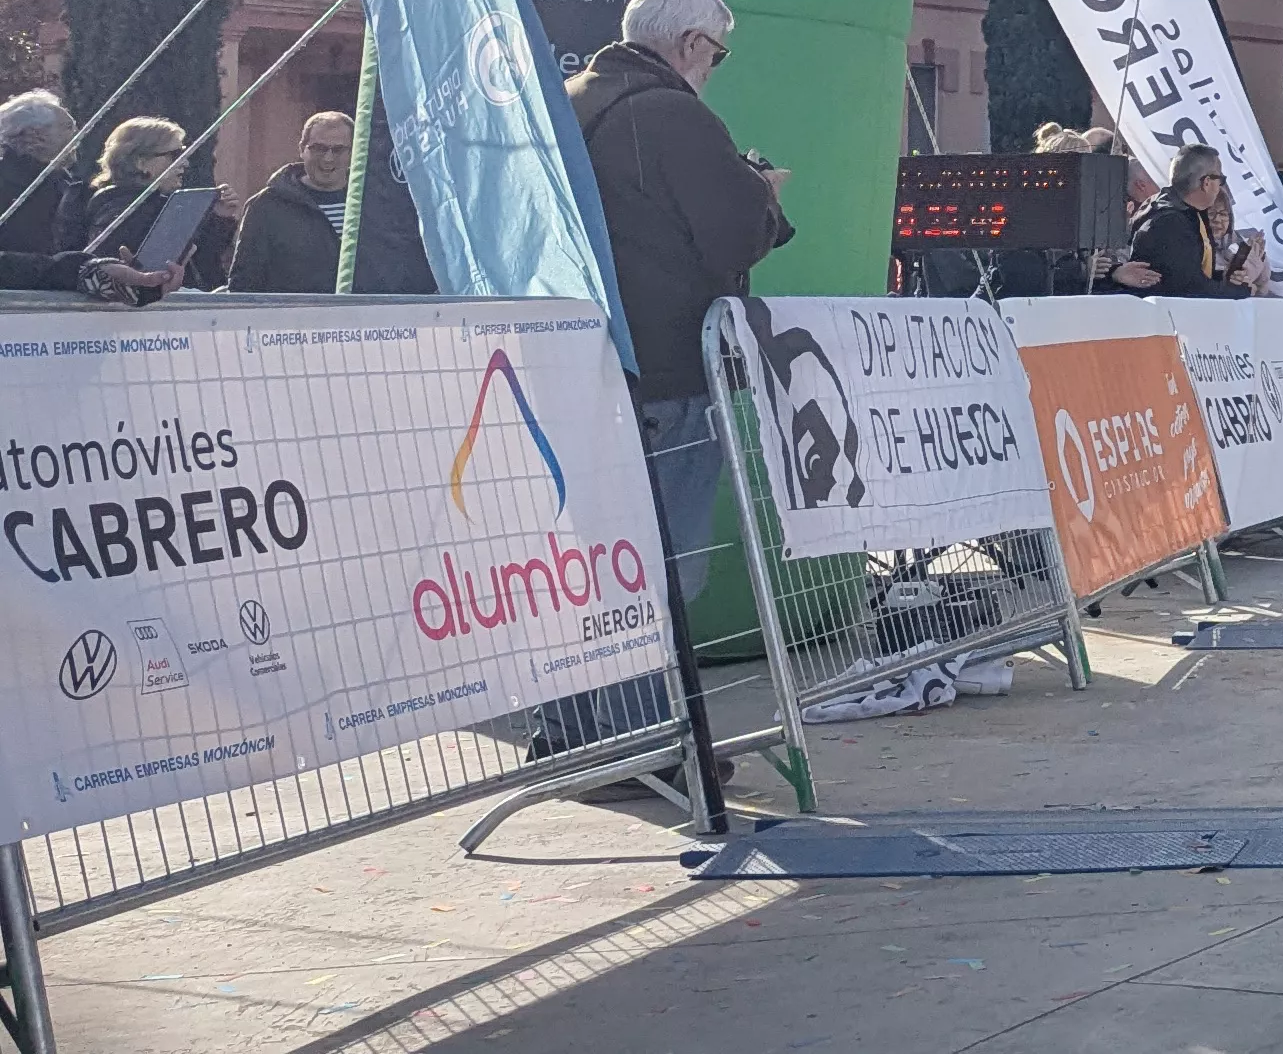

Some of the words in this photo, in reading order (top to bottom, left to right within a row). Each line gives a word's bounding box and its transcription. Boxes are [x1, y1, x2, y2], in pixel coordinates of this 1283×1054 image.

[54, 340, 117, 356] EMPRESAS
[120, 334, 190, 353] MONZÓNCM
[261, 329, 309, 347] CARRERA
[311, 328, 362, 345] EMPRESAS
[364, 325, 417, 342] MONZÓNCM
[474, 323, 512, 337] CARRERA
[514, 320, 555, 333] EMPRESAS
[556, 317, 602, 332] MONZÓNCM
[851, 300, 1000, 380] DIPUTACIÓN
[0, 418, 239, 491] tomóviles
[869, 407, 912, 474] DE
[913, 402, 1021, 472] HUESCA
[4, 479, 309, 584] CABRERO
[413, 531, 648, 643] alumbra
[582, 594, 656, 642] ENERGÍA
[146, 657, 171, 672] Audi
[146, 671, 184, 687] Service
[544, 653, 582, 675] CARRERA
[338, 709, 386, 731] CARRERA
[386, 694, 435, 719] EMPRESAS
[438, 679, 488, 704] MONZÓNCM
[74, 767, 133, 792] CARRERA
[135, 752, 200, 780] EMPRESAS
[203, 735, 275, 764] MONZÓNCM
